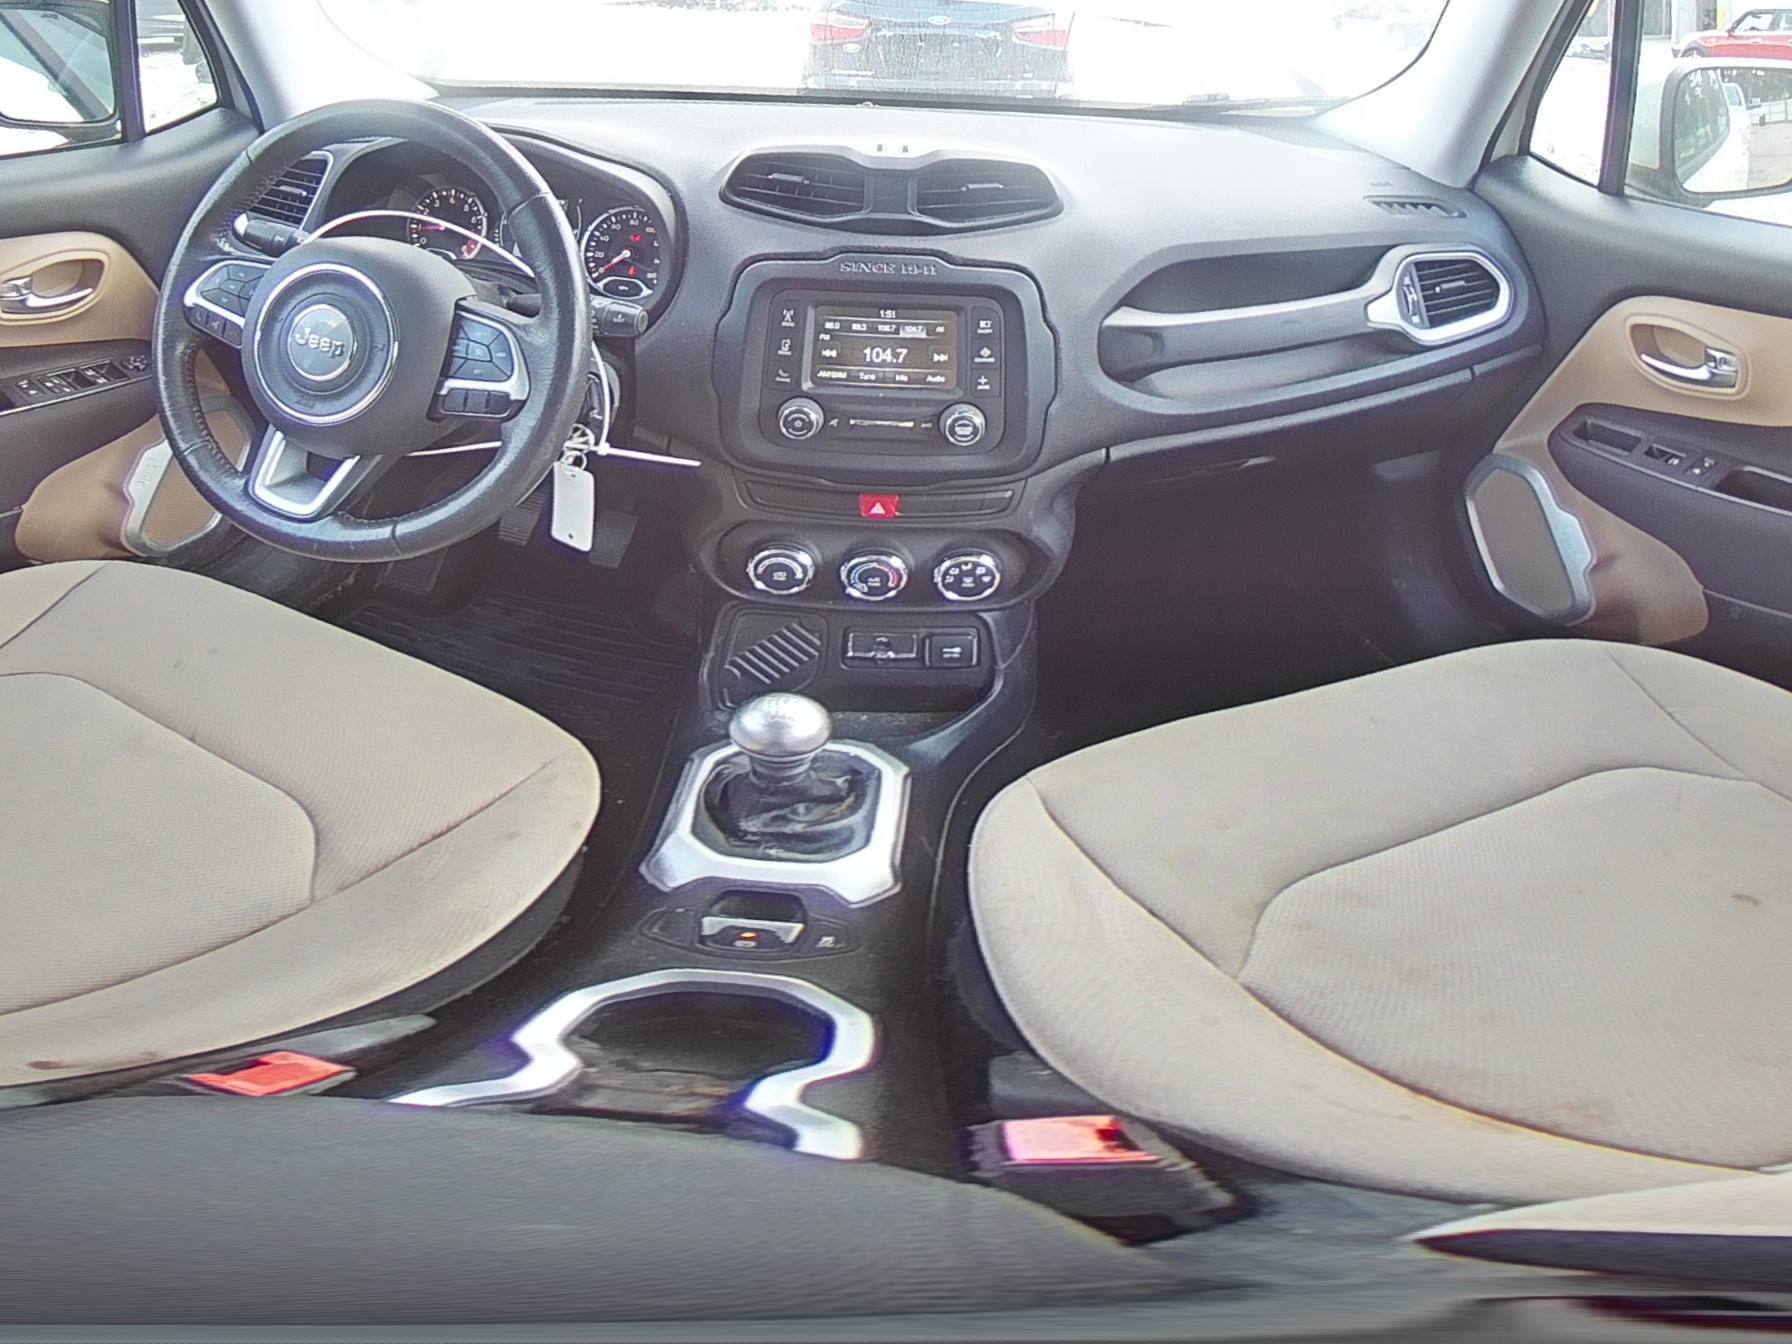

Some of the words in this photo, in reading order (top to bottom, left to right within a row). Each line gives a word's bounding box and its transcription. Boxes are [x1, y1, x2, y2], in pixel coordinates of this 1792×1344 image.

[840, 261, 896, 274] SINCE
[294, 325, 345, 358] Jeep
[863, 346, 908, 364] 104.7
[926, 374, 946, 383] Audio
